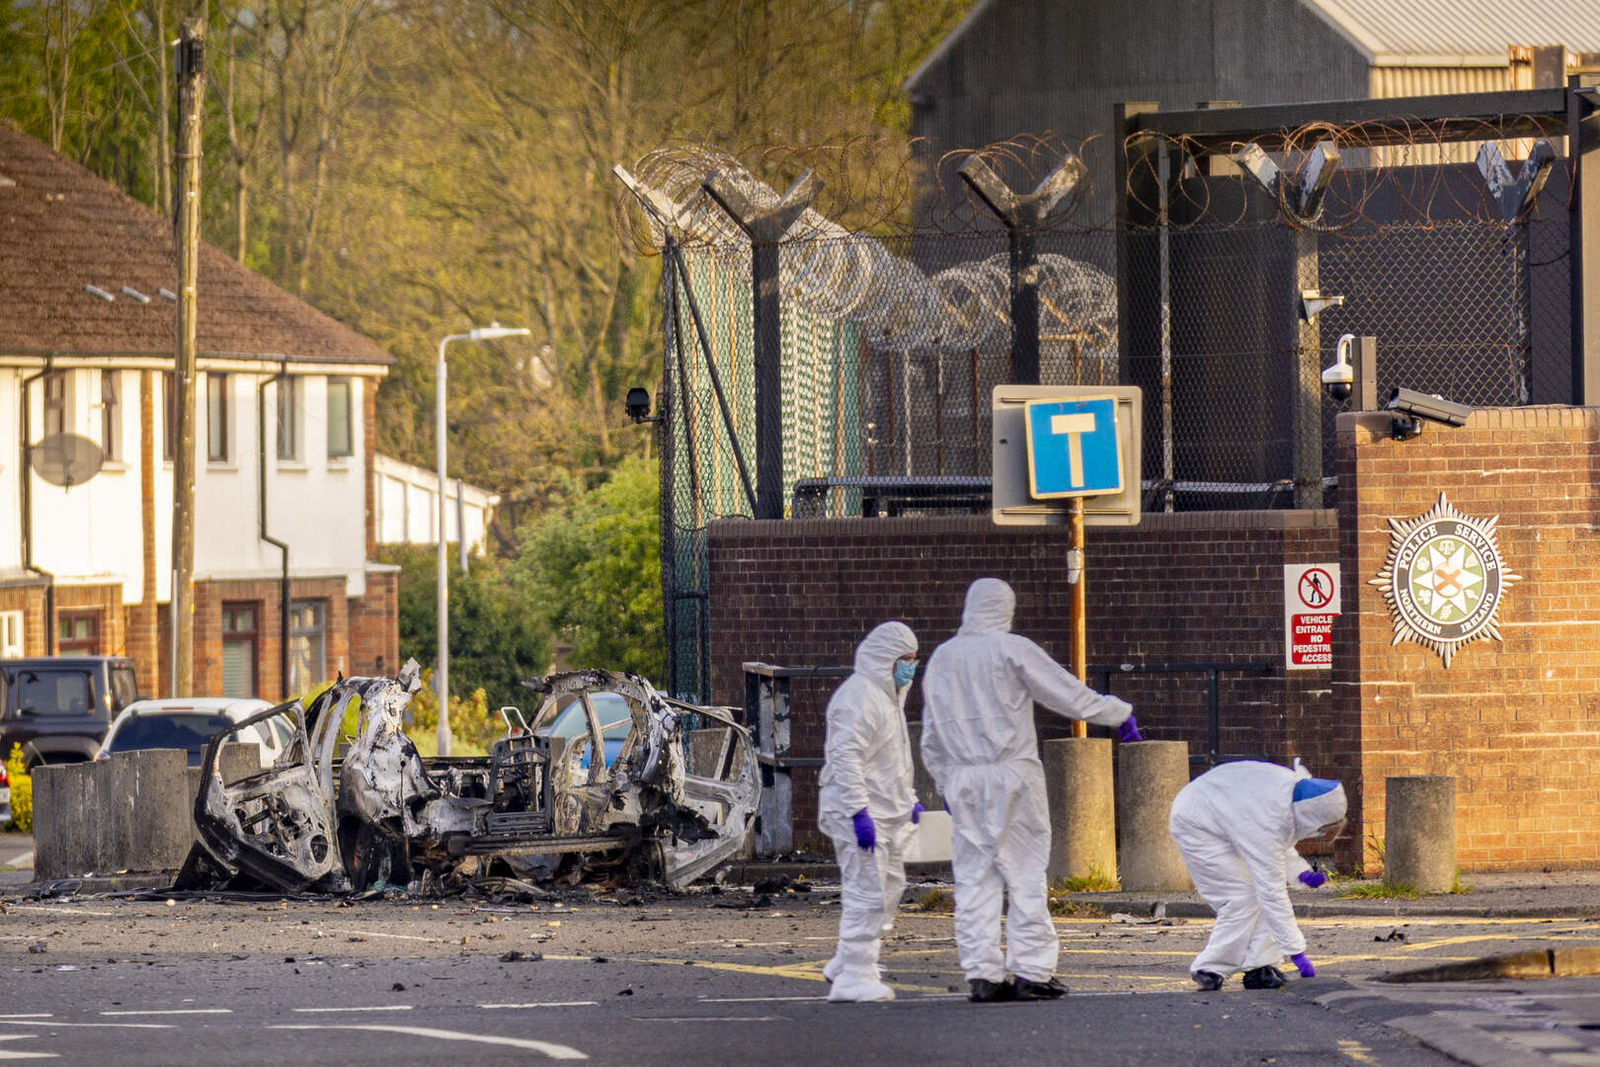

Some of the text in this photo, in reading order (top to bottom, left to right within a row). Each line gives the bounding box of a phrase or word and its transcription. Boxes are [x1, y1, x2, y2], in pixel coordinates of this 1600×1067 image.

[1399, 524, 1497, 571] POLICE SERVICE
[1399, 588, 1494, 635] NORTHERN IRELAND
[1300, 615, 1333, 624] VEHICLE
[1310, 635, 1323, 643] NO
[1293, 644, 1332, 653] PEDESTRI
[1302, 653, 1333, 663] ACCESS
